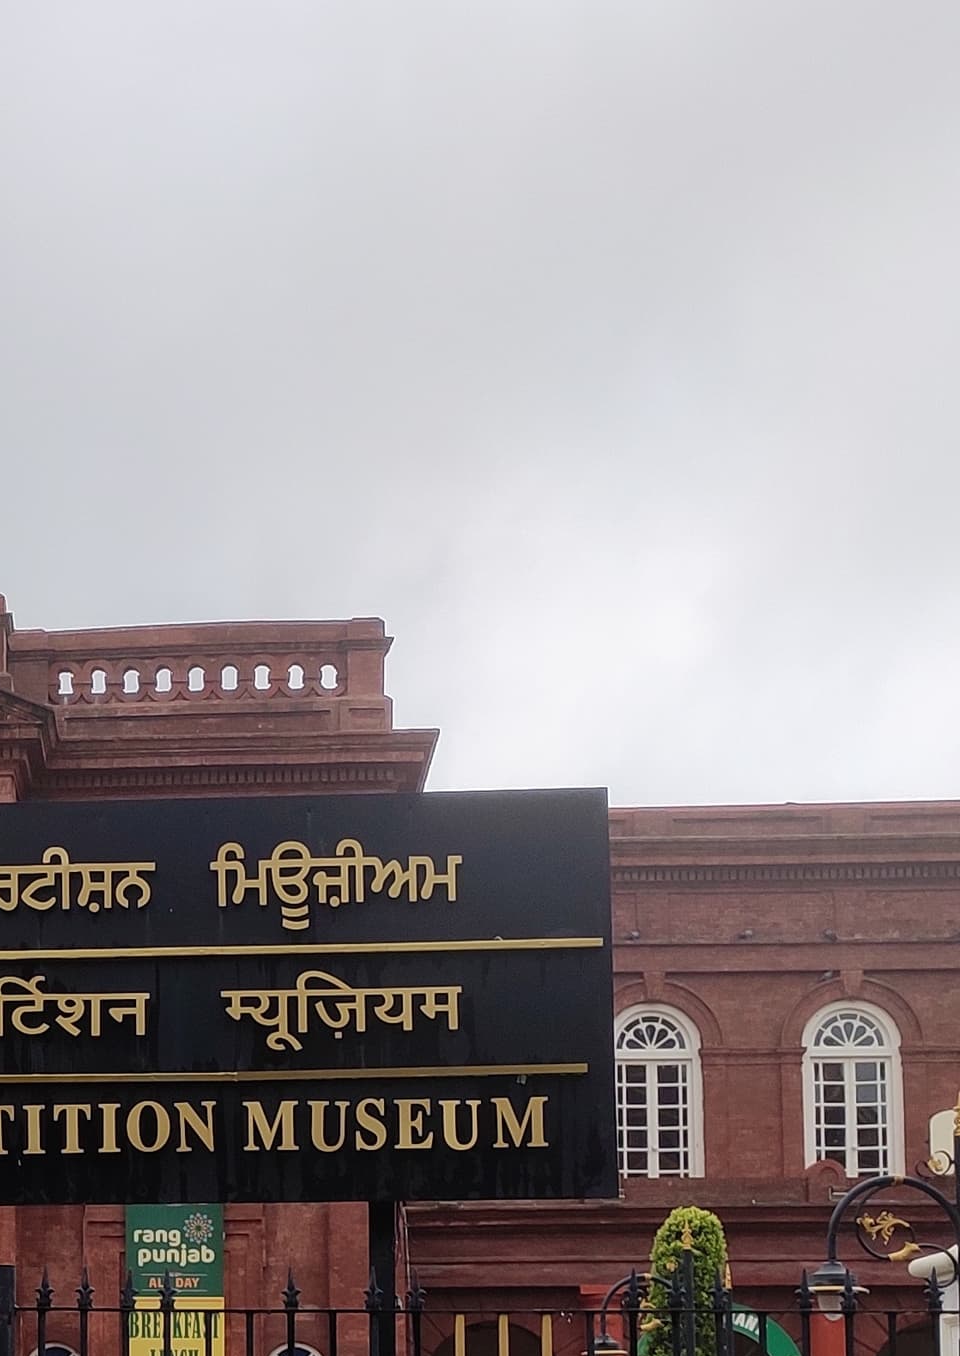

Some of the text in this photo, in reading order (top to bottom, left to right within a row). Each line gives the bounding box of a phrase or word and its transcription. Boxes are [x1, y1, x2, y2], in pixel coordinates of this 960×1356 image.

[210, 839, 462, 929] ਮਿਊਜ਼ੀਅਮ
[221, 971, 462, 1050] म्यूज़ियम
[243, 1097, 548, 1152] MUSEUM
[133, 1228, 181, 1246] rang
[137, 1246, 216, 1267] punjab
[149, 1277, 200, 1289] AL DAY
[129, 1311, 221, 1339] BREKFAT
